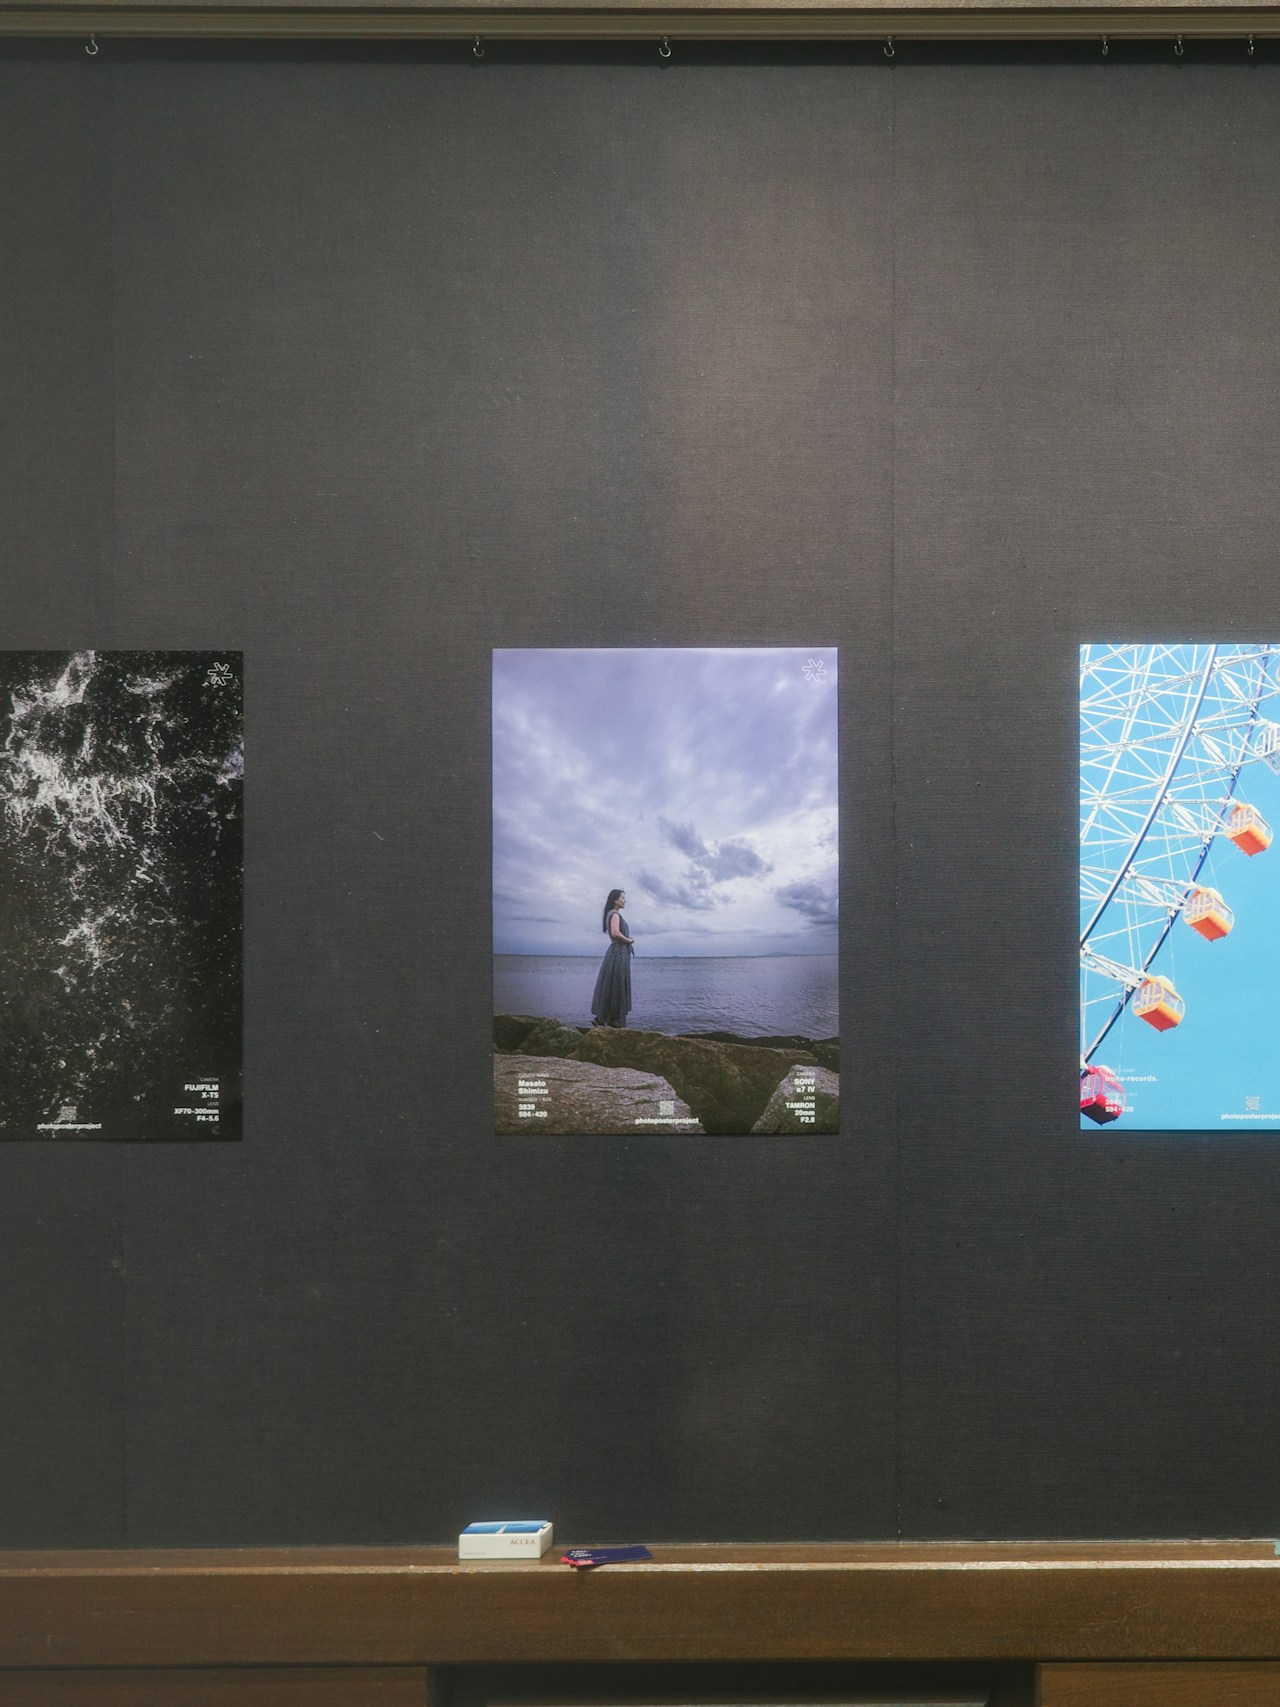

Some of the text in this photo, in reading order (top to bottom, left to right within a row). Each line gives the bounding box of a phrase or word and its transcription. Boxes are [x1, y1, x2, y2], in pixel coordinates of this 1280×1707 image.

[201, 1091, 219, 1099] X-T5
[518, 1087, 549, 1095] Shimizu
[174, 1107, 220, 1115] XF70-300mm
[196, 1114, 220, 1122] F4-5.6
[635, 1117, 700, 1125] photoposterproject
